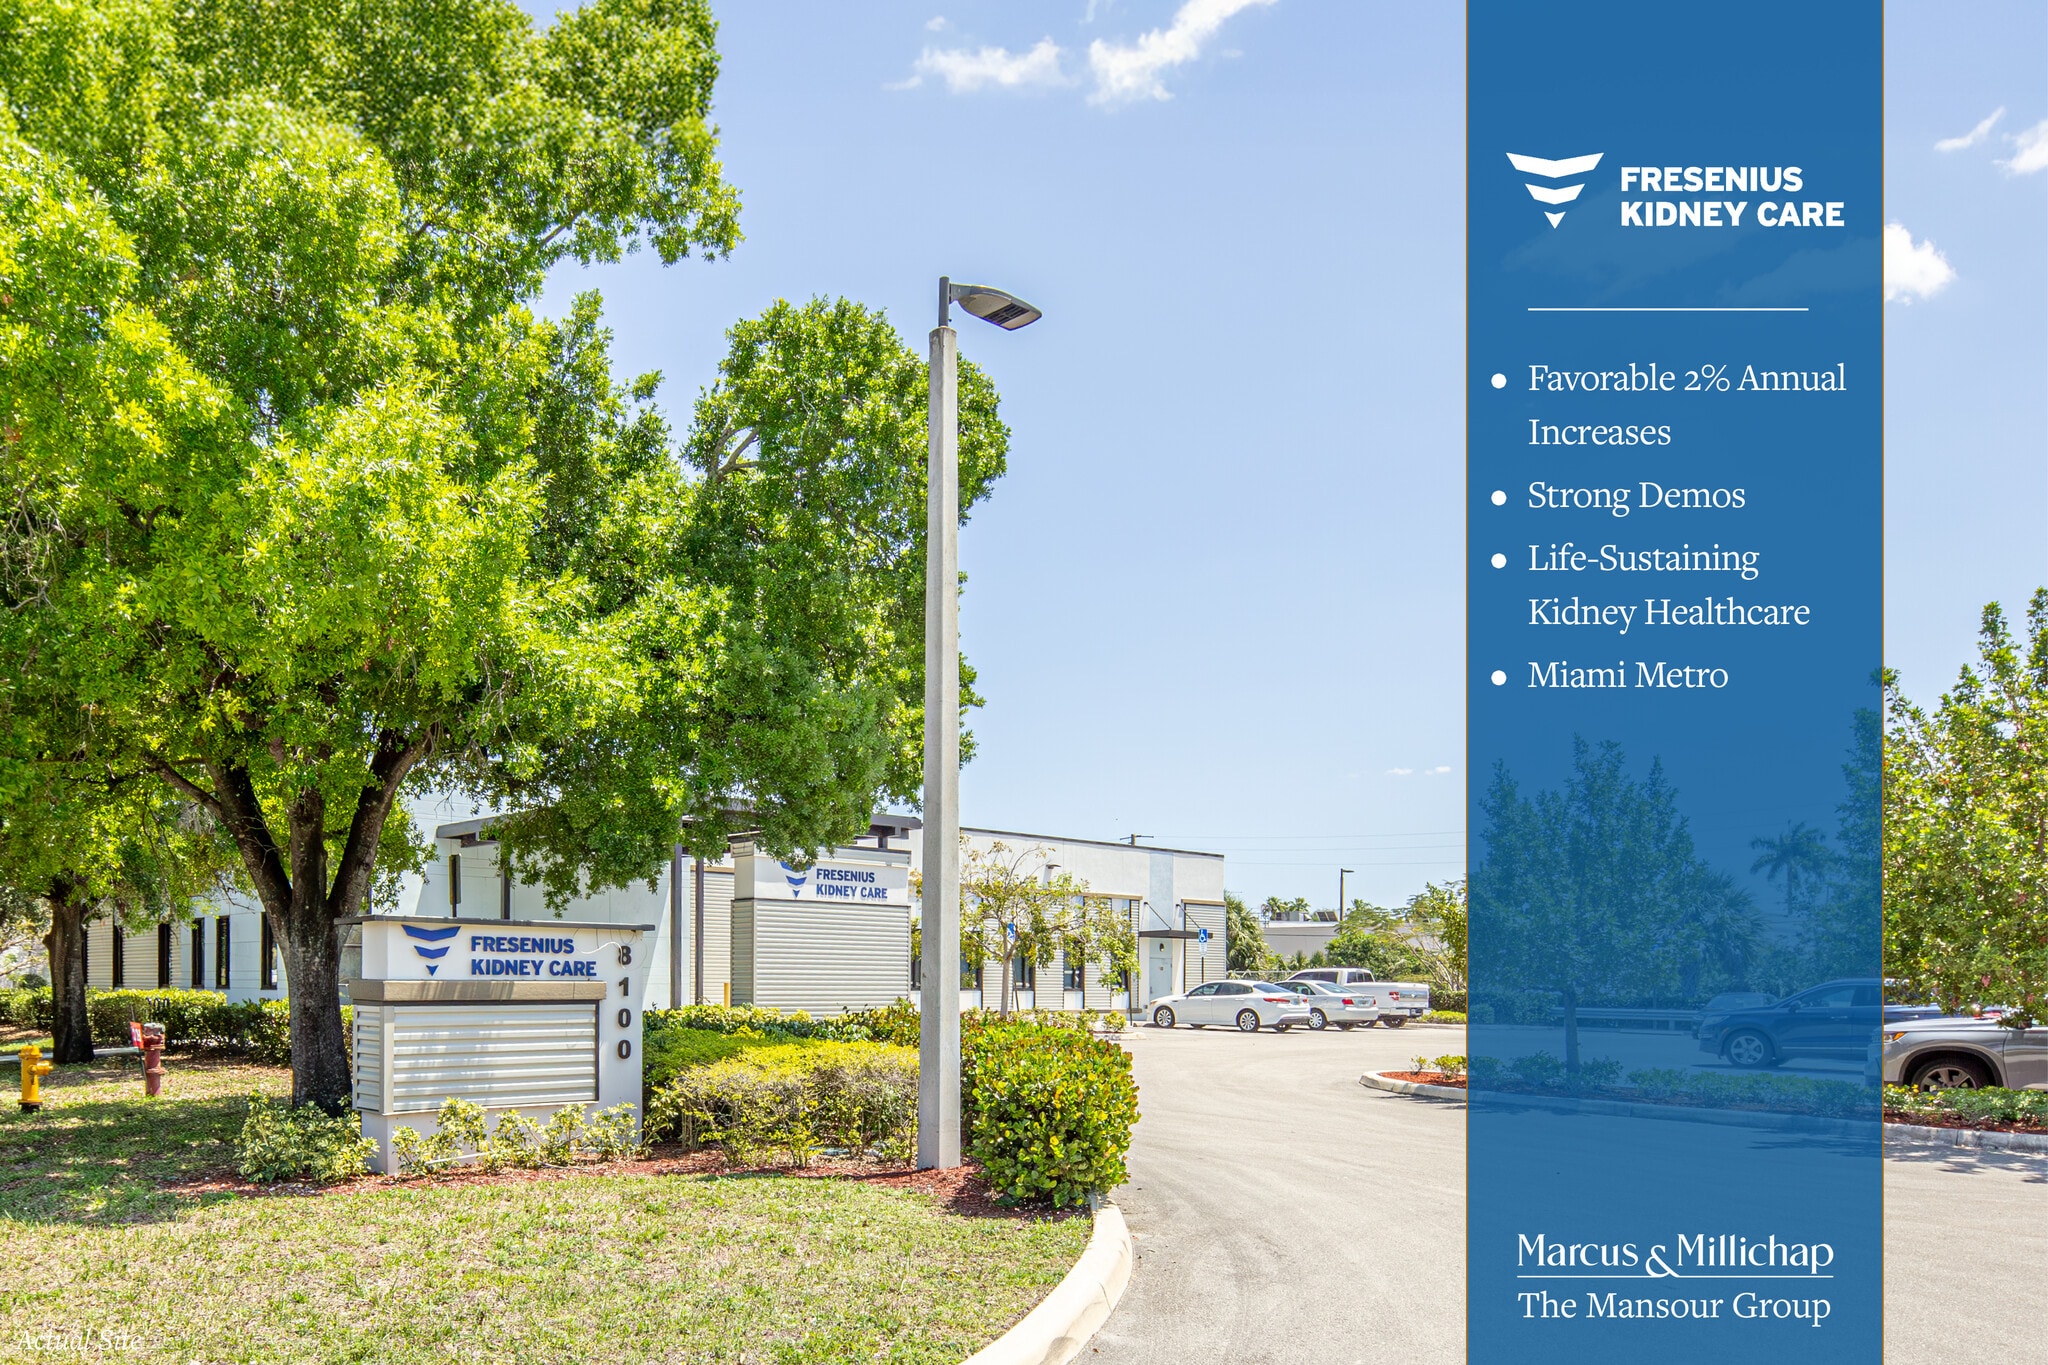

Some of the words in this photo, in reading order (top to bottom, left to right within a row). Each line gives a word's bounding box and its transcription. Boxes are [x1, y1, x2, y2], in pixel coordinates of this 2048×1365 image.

[816, 868, 875, 883] FRESENIUS
[816, 883, 857, 897] KIDNEY
[860, 886, 888, 899] CARE
[471, 935, 575, 955] FRESENIUS
[471, 958, 545, 976] KIDNEY
[549, 960, 598, 977] CARE
[617, 945, 632, 1060] 8100
